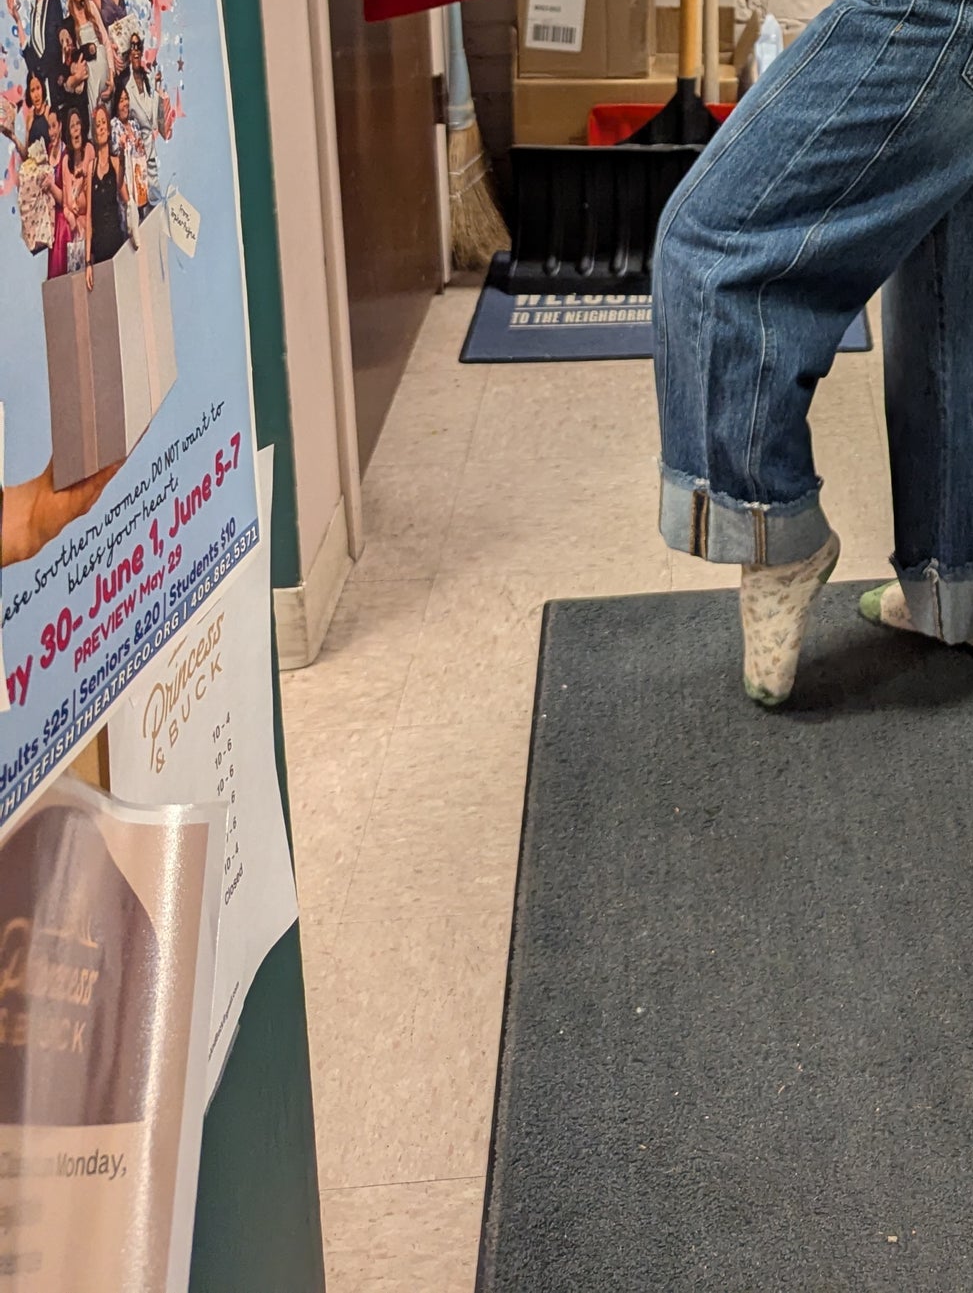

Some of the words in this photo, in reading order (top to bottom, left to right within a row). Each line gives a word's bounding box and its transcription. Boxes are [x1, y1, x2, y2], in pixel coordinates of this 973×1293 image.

[511, 311, 530, 324] TO
[534, 311, 561, 324] THE
[34, 522, 103, 594] Southern
[104, 478, 151, 526] women
[151, 456, 162, 482] DO
[164, 439, 180, 471] NOT
[182, 412, 211, 452] want
[211, 400, 225, 422] to
[68, 546, 105, 595] bless
[106, 511, 142, 568] your
[88, 544, 144, 619] June
[149, 518, 164, 558] 1,
[168, 473, 212, 538] June
[214, 431, 241, 487] 5-7
[0, 611, 180, 818] HITEFISHTHEATRECO.ORG
[190, 526, 258, 608] 406.862.5371
[43, 698, 69, 746] $25
[79, 637, 130, 704] Seniors
[133, 601, 160, 645] &20
[169, 541, 219, 607] Students
[220, 517, 236, 550] $10
[74, 589, 137, 673] PREVIEW
[139, 565, 165, 603] May
[167, 543, 182, 574] 29
[143, 611, 225, 771] Princess
[168, 651, 223, 749] BUCK
[224, 862, 243, 906] Closed
